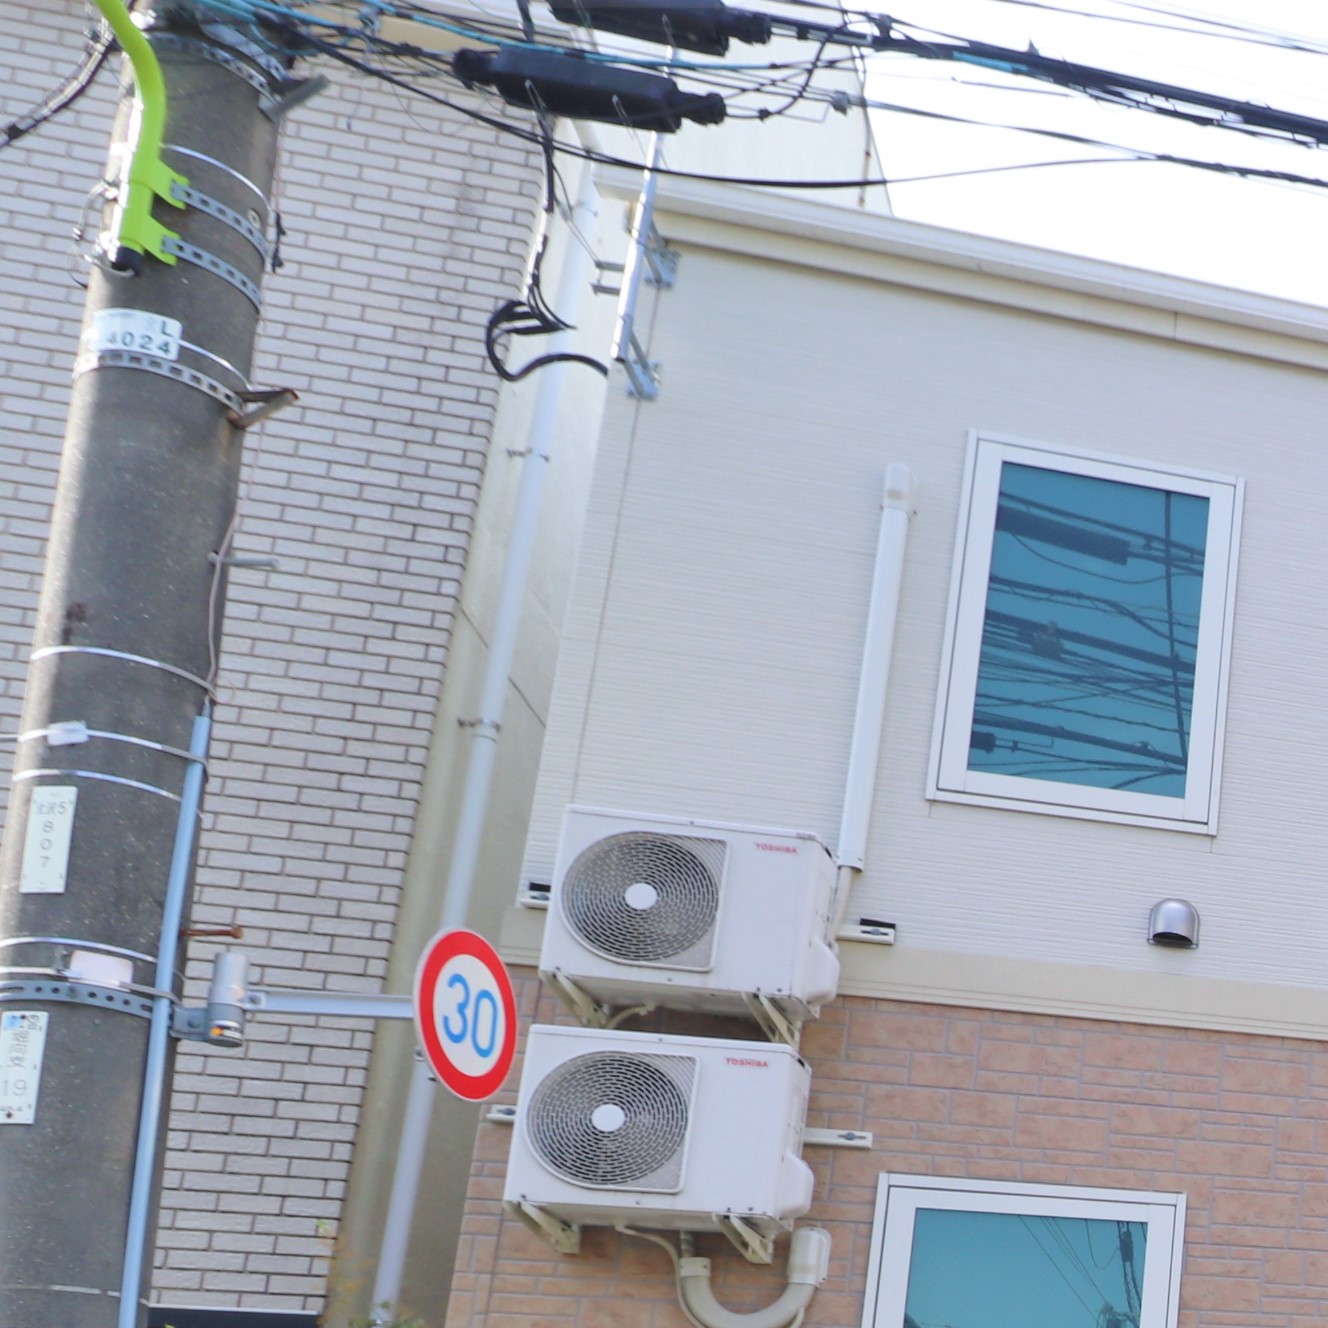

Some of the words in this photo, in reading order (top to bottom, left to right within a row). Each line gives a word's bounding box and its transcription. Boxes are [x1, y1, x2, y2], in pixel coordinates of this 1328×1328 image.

[753, 842, 798, 855] TOSHIBA
[442, 973, 498, 1058] 30
[725, 1057, 769, 1068] TOSHIBA
